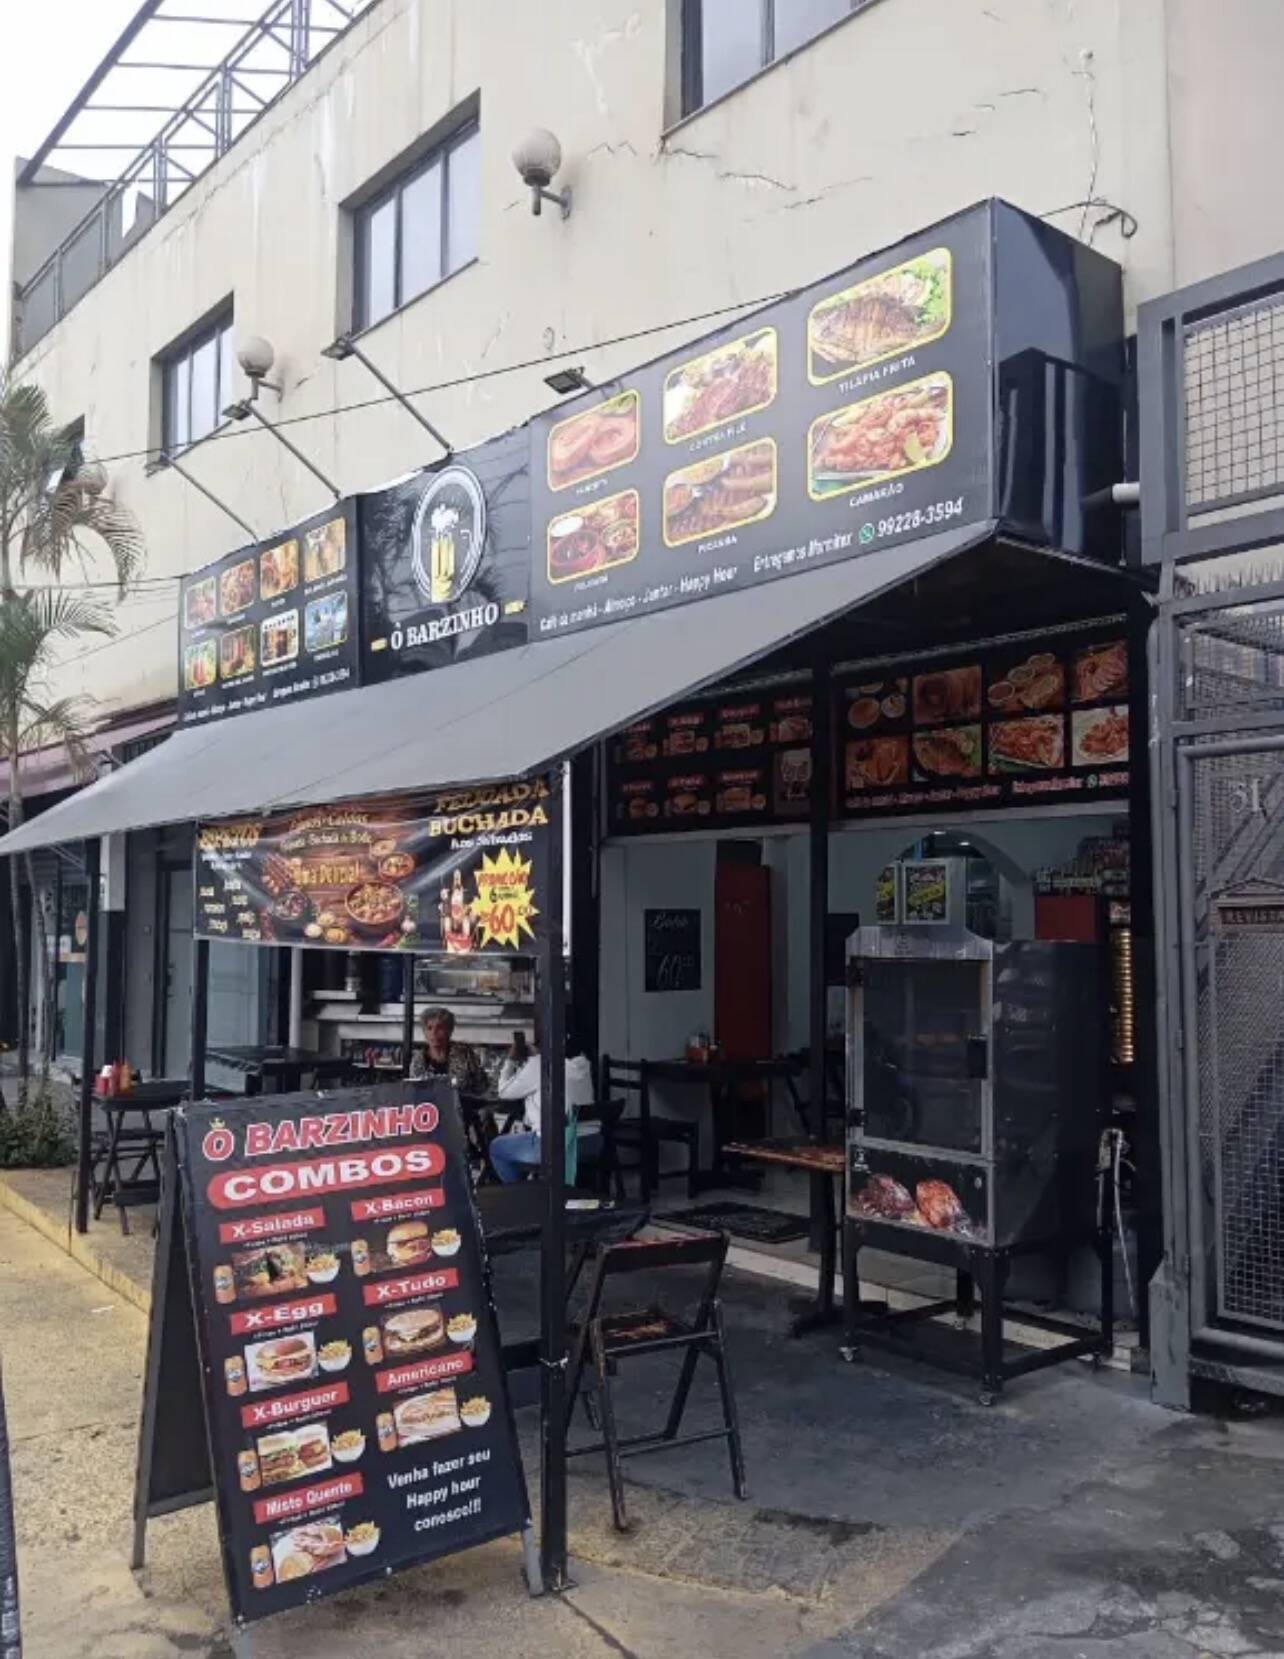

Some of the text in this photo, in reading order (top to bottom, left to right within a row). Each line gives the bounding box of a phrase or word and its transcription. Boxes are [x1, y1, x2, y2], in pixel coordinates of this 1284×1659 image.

[877, 496, 965, 538] 99228-3594
[680, 574, 711, 594] Happy
[406, 602, 499, 647] BARZINHO
[428, 804, 549, 838] BUCHADA
[244, 1102, 440, 1157] BARZINHO
[223, 1150, 433, 1201] COMBOS
[364, 1195, 433, 1215] X-Bacon
[231, 1214, 315, 1239] X-Salada
[376, 1275, 446, 1300] X-Tudo
[244, 1302, 324, 1329] X-Egg
[387, 1359, 464, 1387] Americano
[253, 1390, 339, 1421] X-Burguer
[387, 1448, 490, 1489] Venha fazer seu
[266, 1496, 303, 1516] Misto
[306, 1482, 353, 1505] Quente
[406, 1475, 481, 1509] Happy hour
